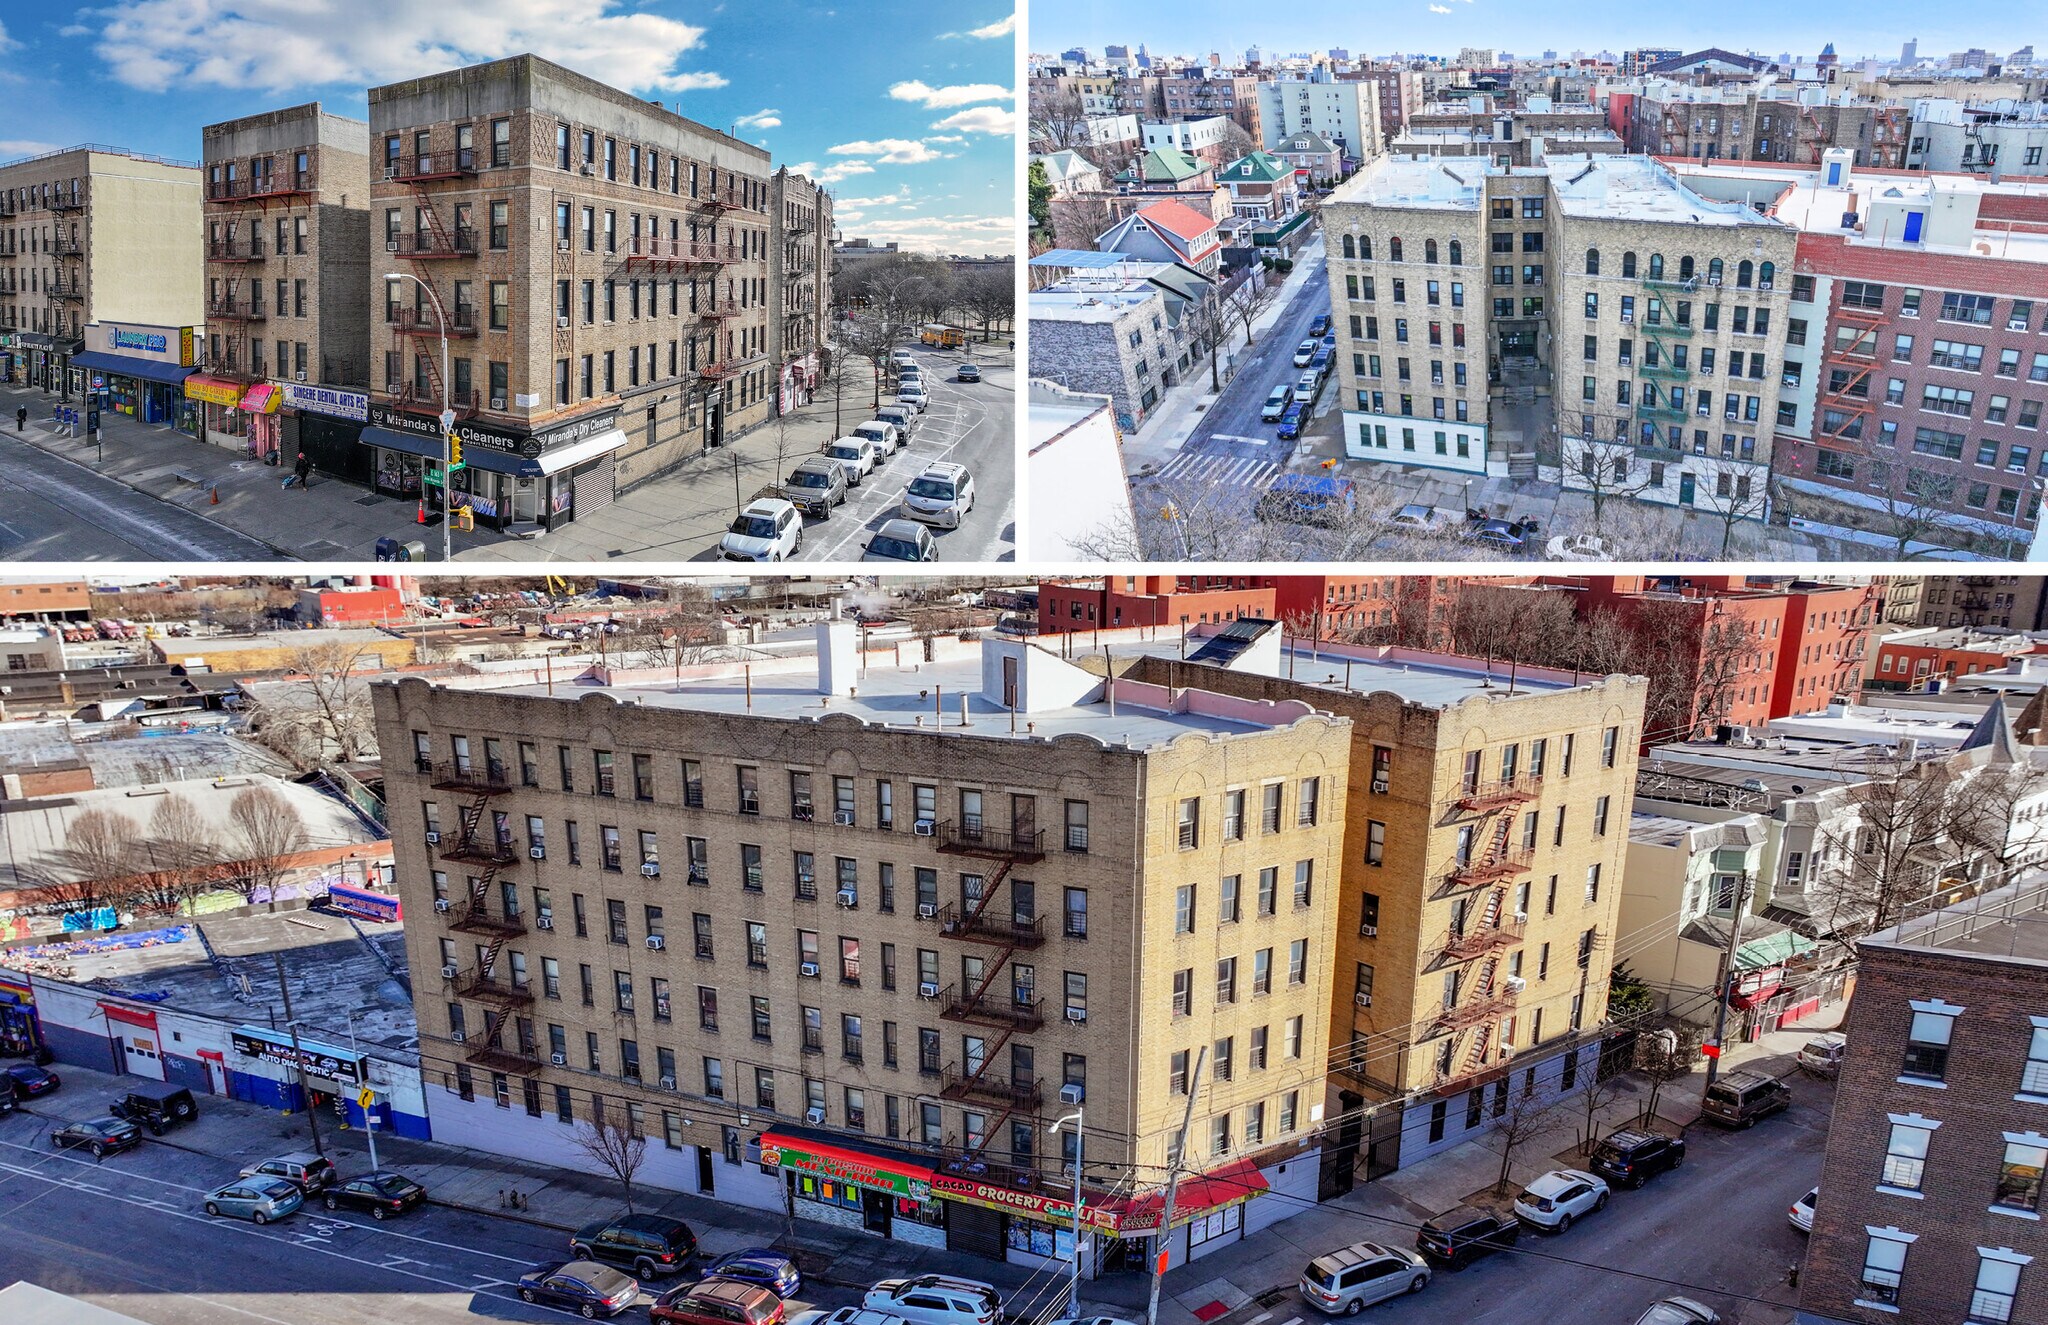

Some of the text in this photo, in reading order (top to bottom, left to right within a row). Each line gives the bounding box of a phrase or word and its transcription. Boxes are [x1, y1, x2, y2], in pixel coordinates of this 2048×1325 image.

[117, 331, 149, 346] LAUNDRY
[149, 335, 166, 348] PRO
[294, 386, 316, 401] SINCERE
[317, 390, 338, 405] DENTAL
[339, 394, 354, 408] ARTS
[386, 413, 514, 448] Miranda's Dy Cleaners
[547, 416, 614, 445] Miranda's Dry Cleaners
[464, 439, 507, 452] Expert Tailoring
[258, 1052, 330, 1077] AUTO DIAGOSTIC
[794, 1159, 894, 1189] MEXICANA
[936, 1180, 975, 1193] CACAO
[977, 1185, 1042, 1209] GROCERY
[1043, 1201, 1054, 1214] &
[1059, 1203, 1093, 1221] DLI
